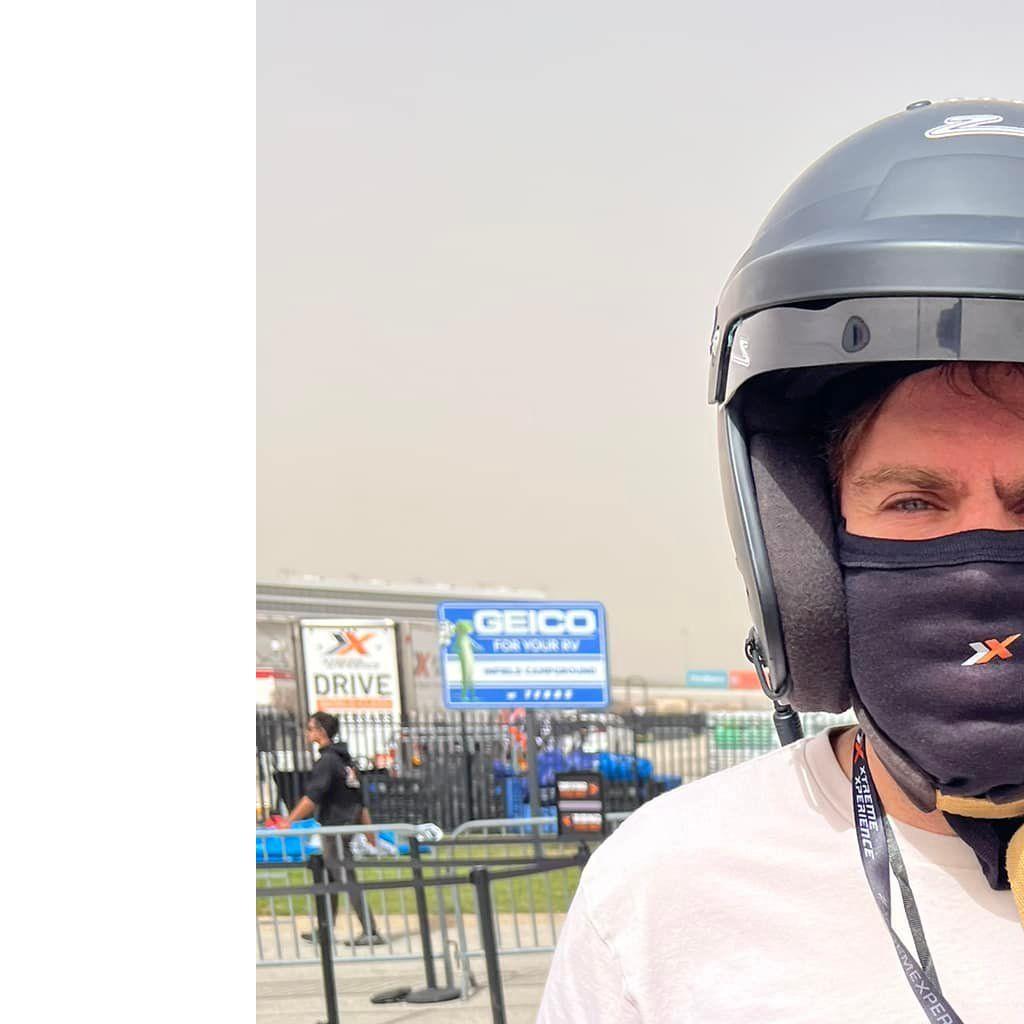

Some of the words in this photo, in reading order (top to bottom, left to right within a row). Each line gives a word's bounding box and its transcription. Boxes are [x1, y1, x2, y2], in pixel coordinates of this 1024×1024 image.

[473, 608, 597, 636] GEICO
[493, 639, 521, 650] FOR
[524, 639, 560, 650] YOUR
[561, 639, 580, 650] RV
[313, 673, 393, 696] DRIVE
[859, 764, 879, 833] XTREME
[854, 775, 875, 860] XPERIENCE
